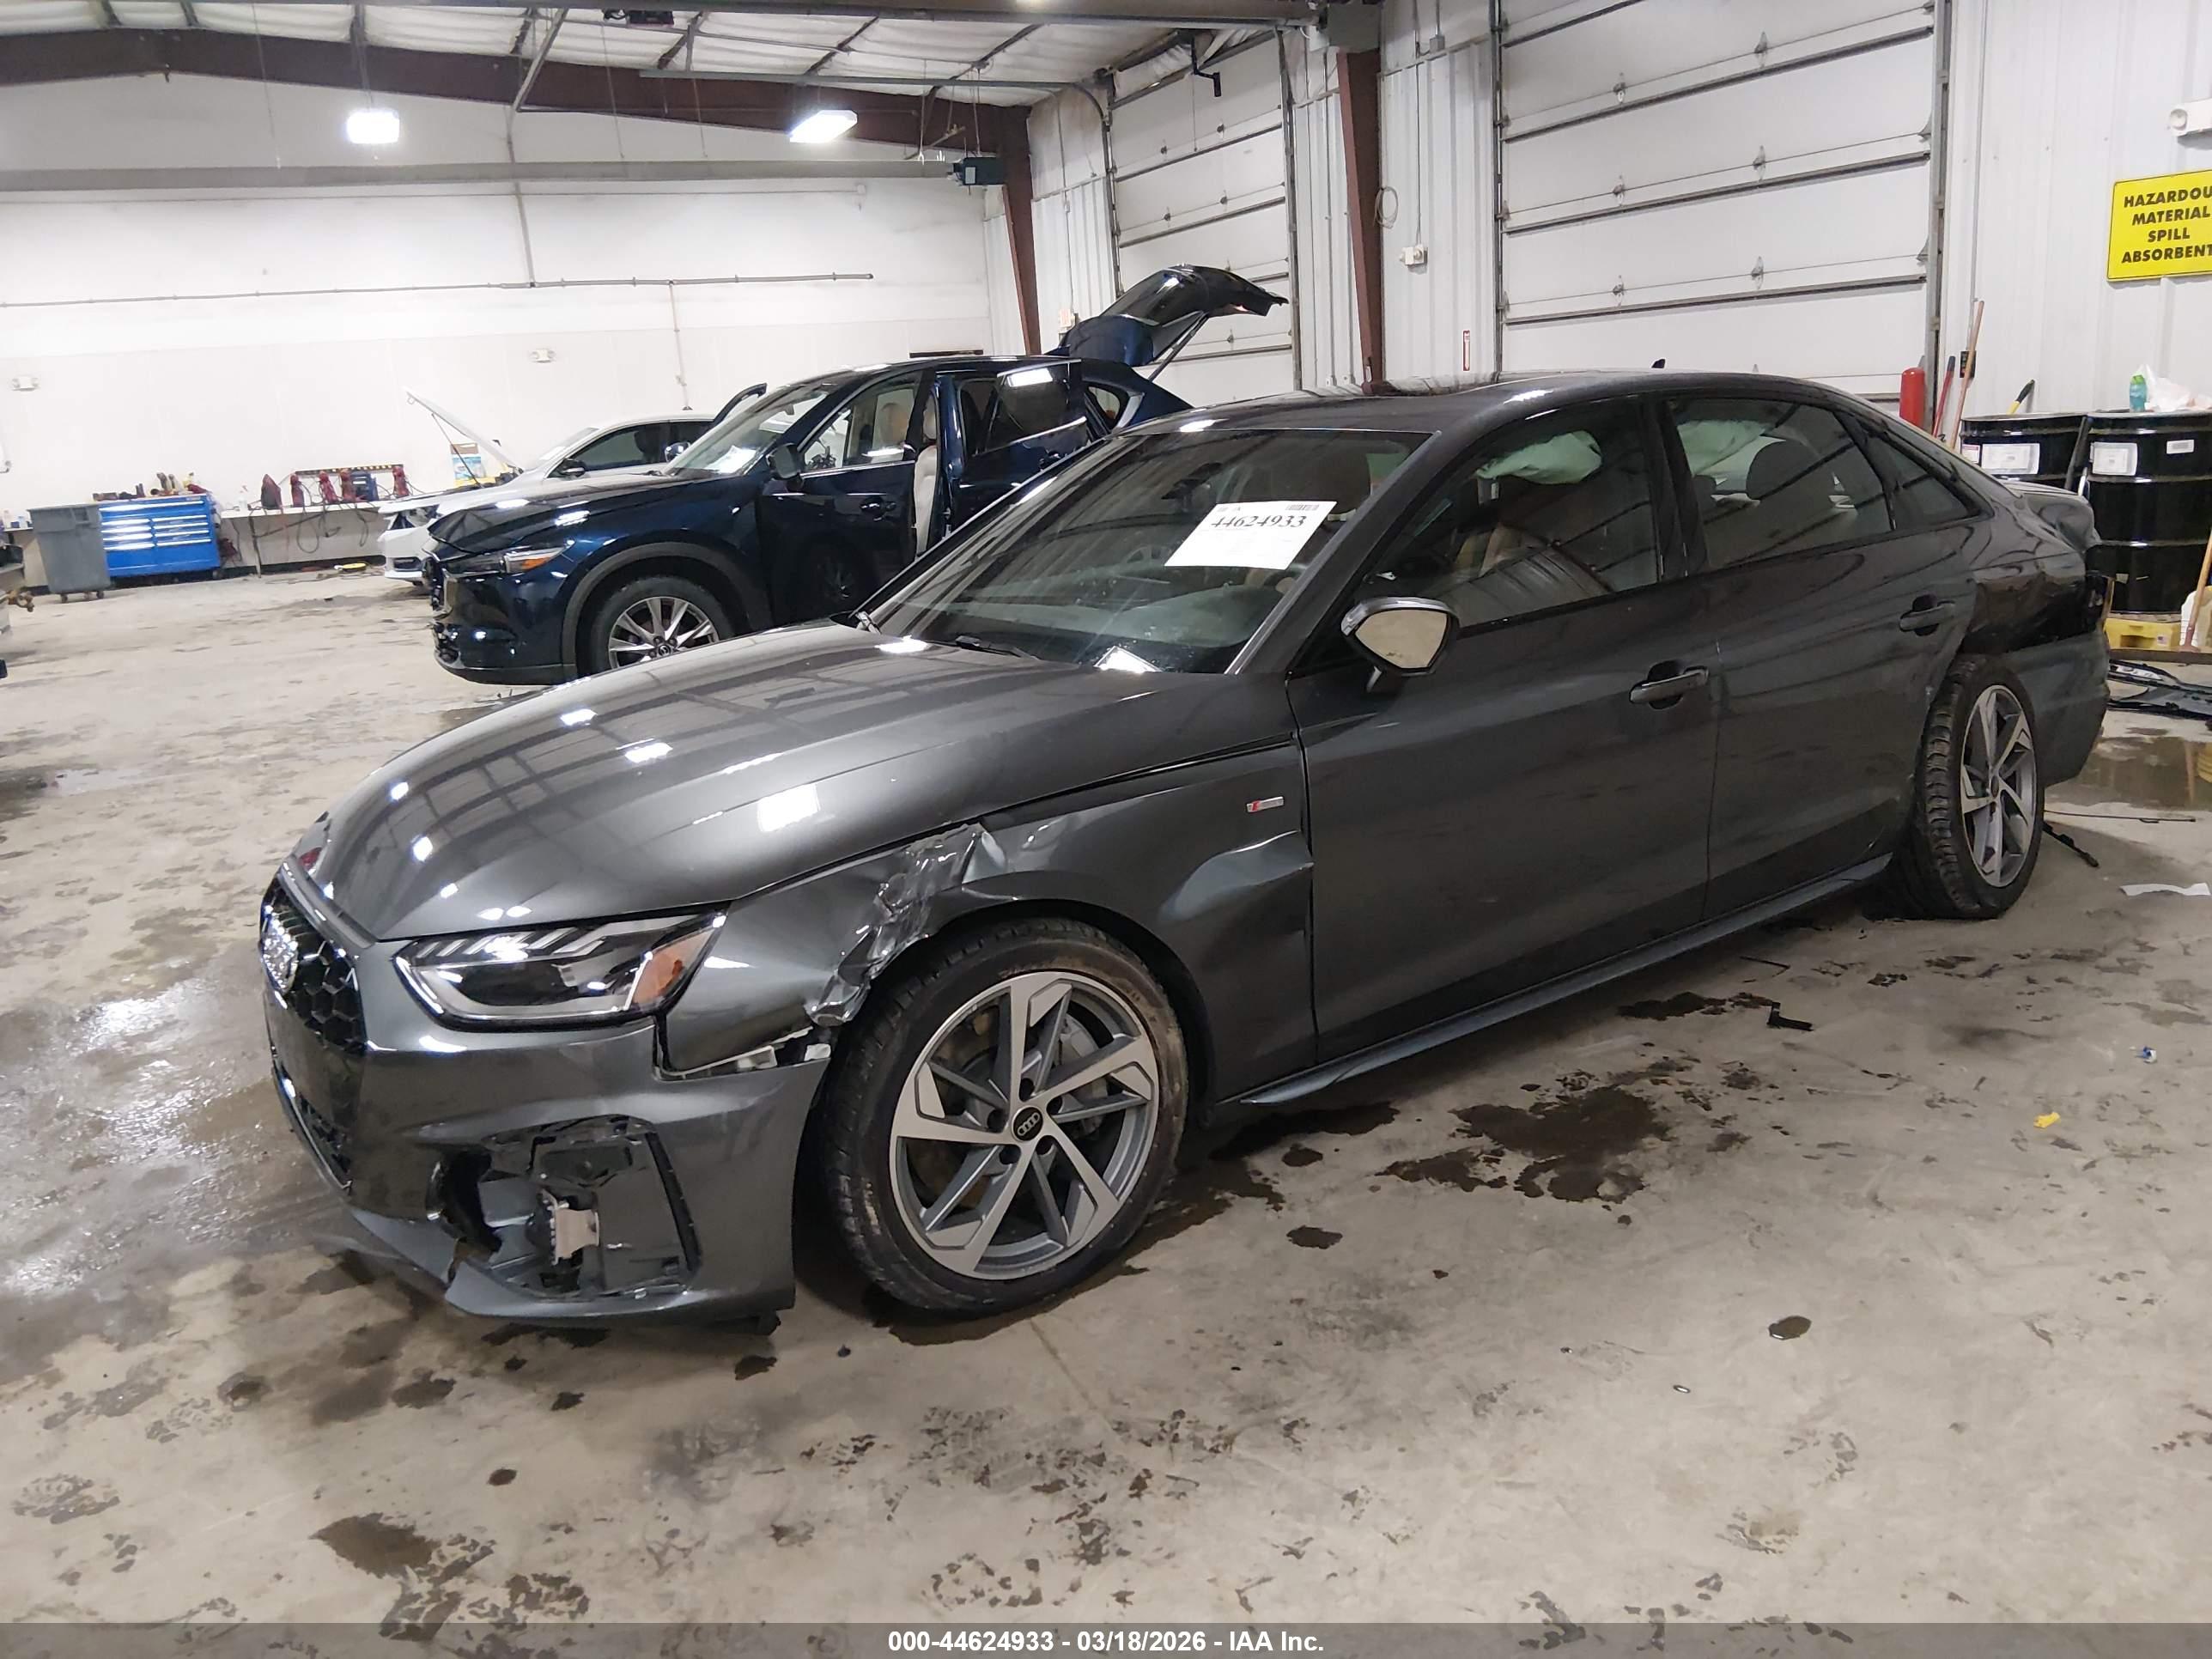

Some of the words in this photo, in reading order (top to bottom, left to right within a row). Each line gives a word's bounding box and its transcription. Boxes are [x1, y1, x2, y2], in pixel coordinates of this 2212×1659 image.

[2131, 205, 2211, 226] MATERIAL
[2148, 227, 2191, 243] SPILL
[1211, 514, 1308, 528] 44624933
